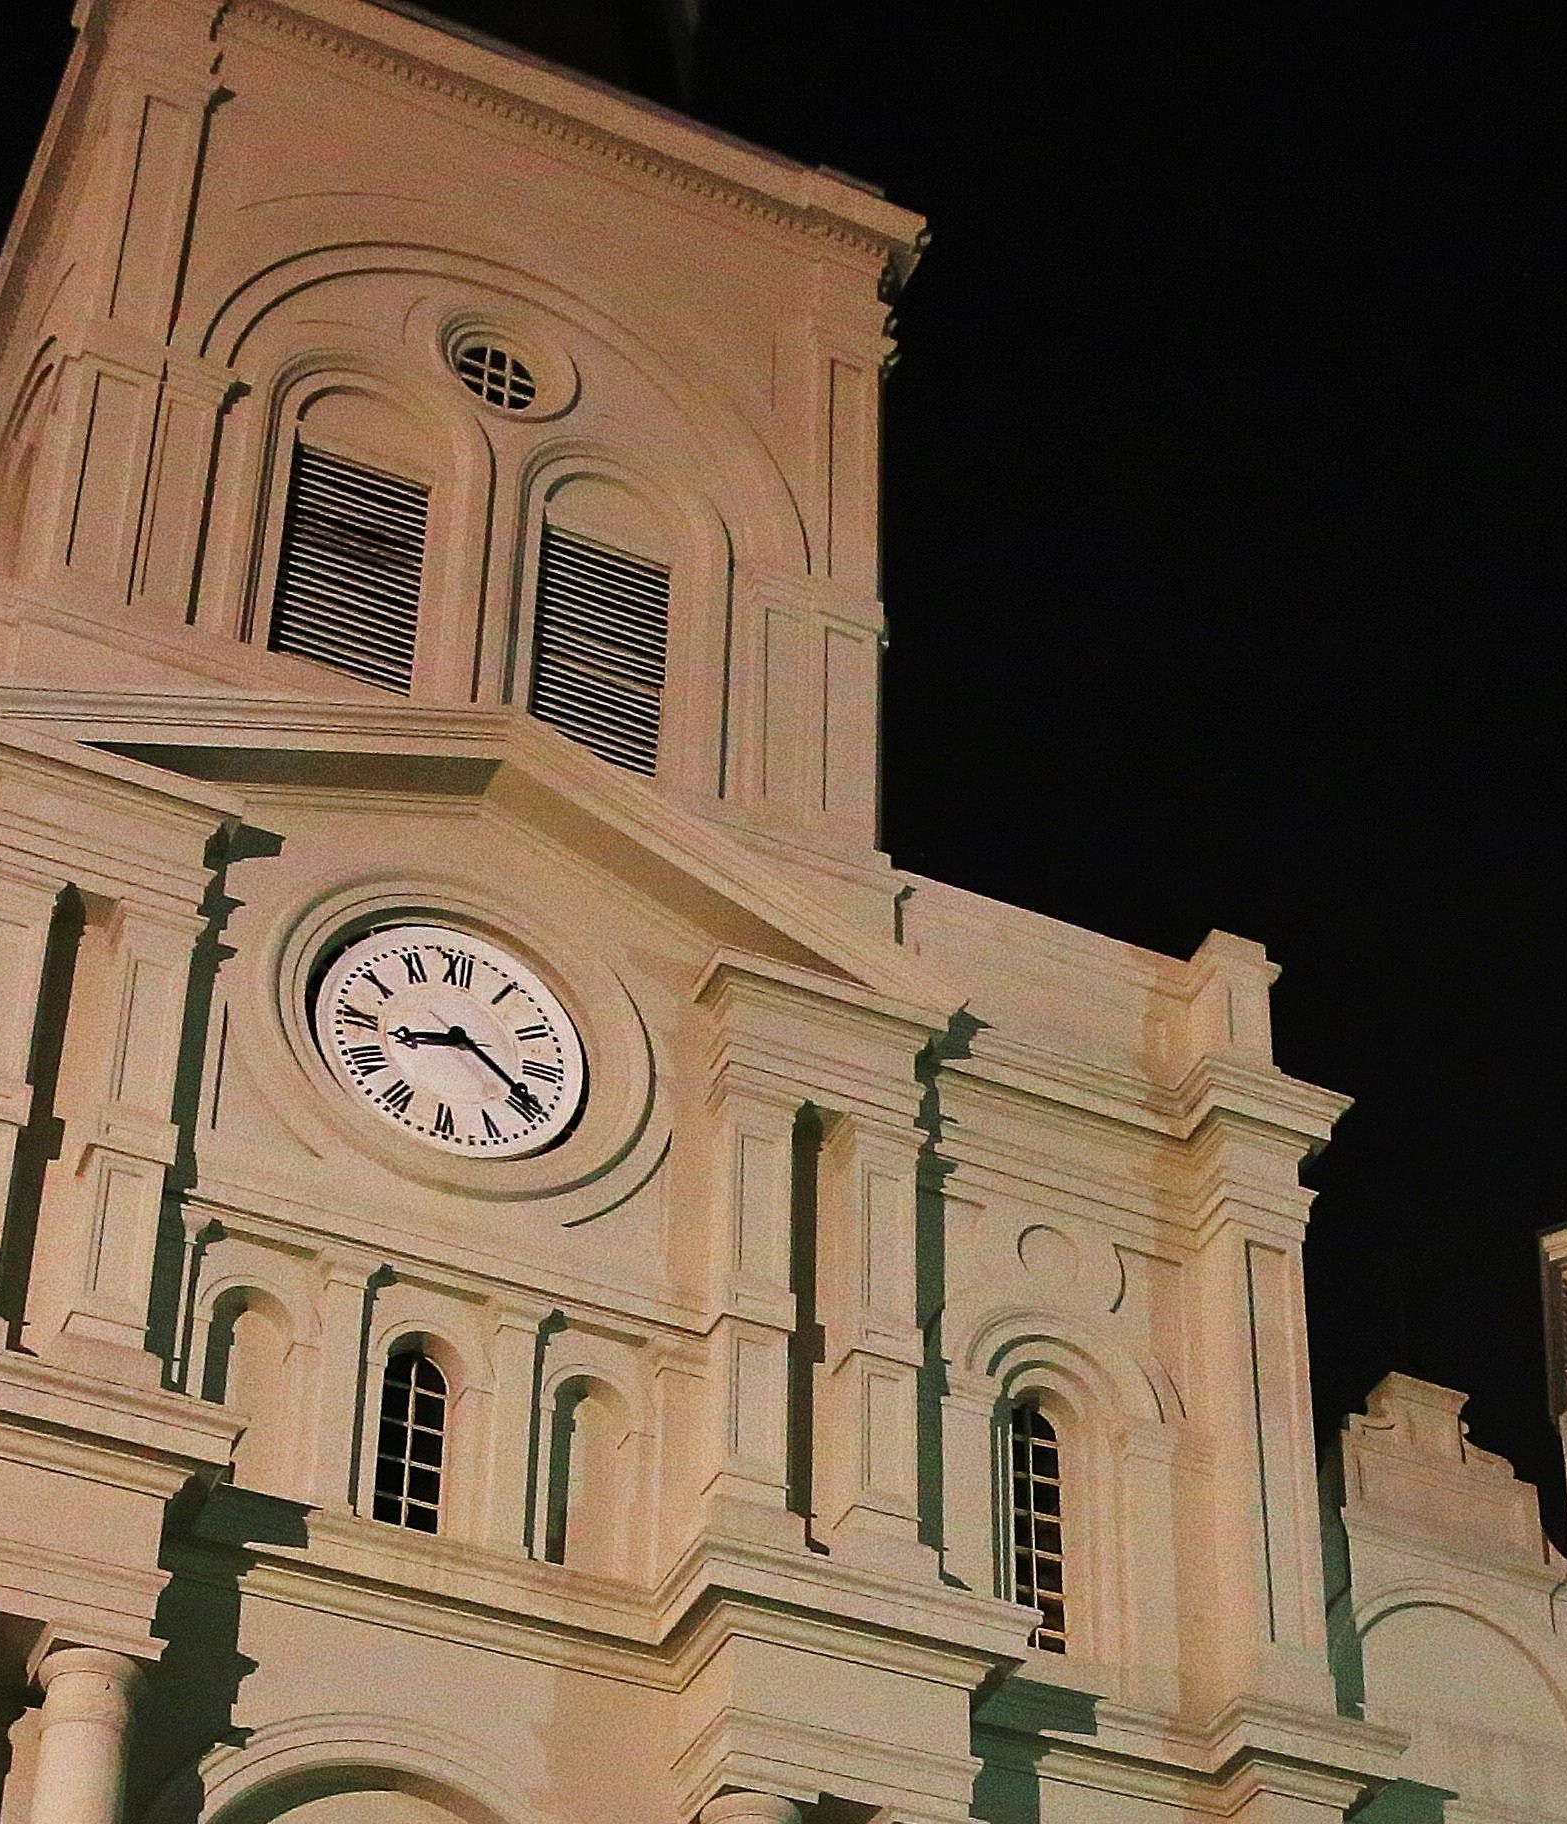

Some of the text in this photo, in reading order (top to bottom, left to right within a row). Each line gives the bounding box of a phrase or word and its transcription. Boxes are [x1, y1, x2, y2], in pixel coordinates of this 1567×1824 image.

[441, 951, 474, 989] XII
[361, 969, 394, 999] X
[514, 1024, 549, 1041] II
[522, 1059, 561, 1083] III
